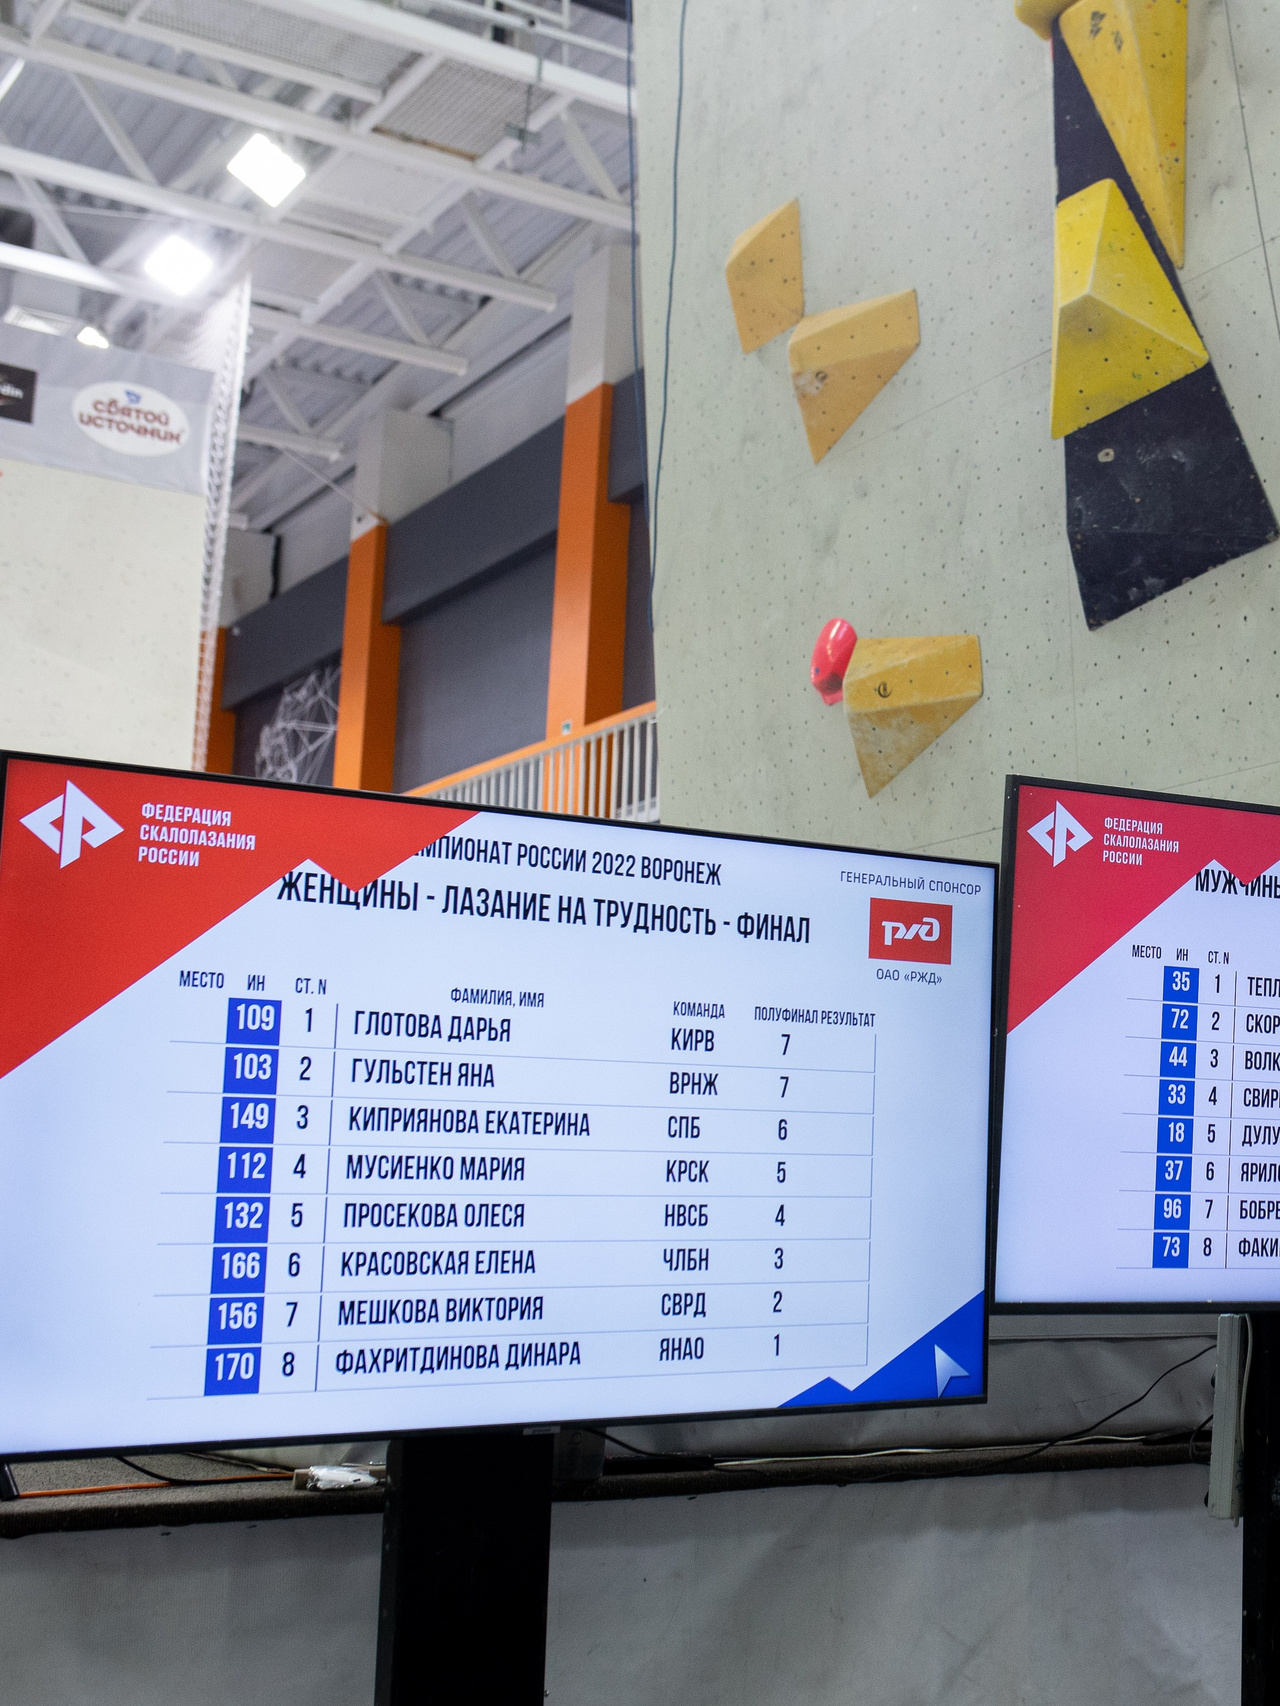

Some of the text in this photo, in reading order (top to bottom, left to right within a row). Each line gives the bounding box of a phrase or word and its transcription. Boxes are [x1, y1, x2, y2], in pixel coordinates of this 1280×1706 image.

[141, 802, 232, 827] ФЕДЕРАЦИЯ
[1104, 816, 1163, 835] ФЕДЕРАЦИЯ
[139, 824, 256, 851] СКАЛОЛАЗАНИЯ
[1103, 833, 1179, 853] СКАЛОЛАЗАНИЯ
[139, 846, 199, 866] РОССИИ
[517, 843, 586, 872] РОССИИ
[592, 852, 635, 877] 2022
[641, 856, 721, 885] ВОРОНЕЖ
[1103, 850, 1142, 865] РОССИИ
[841, 871, 981, 895] ГЕНЕРАЛЬНЫЙ СПОНСОР
[442, 885, 551, 922] ЛАЗАНИЕ
[558, 896, 586, 925] НА
[593, 899, 716, 935] ТРУДНОСТЬ
[737, 912, 809, 943] ФИНАЛ
[1132, 945, 1161, 959] МЕСТО
[1177, 948, 1188, 961] ИН
[1208, 951, 1221, 963] СТ.
[877, 969, 942, 985] ОАО «РЖД»
[1173, 971, 1190, 991] 35
[180, 970, 224, 988] МЕСТО
[247, 975, 265, 991] ИН
[296, 978, 313, 994] СТ.
[451, 988, 515, 1006] ФАМИЛИЯ,
[519, 992, 544, 1007] ИМЯ
[674, 1001, 725, 1019] КОМАНДА
[755, 1006, 818, 1023] ПОЛУФИНАЛ
[821, 1011, 875, 1027] РЕЗУЛЬТАТ
[237, 1004, 714, 1051] 109 ГЛОТОВА ДАРЬЯ КИРВ
[1172, 1008, 1189, 1029] 72
[1169, 1046, 1187, 1066] 44
[234, 1053, 718, 1095] 103 ГУЛЬСТЕН ЯНА ВРНЖ
[1168, 1084, 1185, 1104] 33
[231, 1102, 700, 1138] 149 КИПРИЯНОВА ЕКАТЕРИНА СПБ
[1169, 1122, 1184, 1142] 18
[228, 1152, 709, 1182] 112 МУСИЕНКО МАРИЯ КРСК
[1165, 1160, 1183, 1180] 37
[225, 1202, 708, 1228] 132 ПРОСЕКОВА ОЛЕСЯ НВСБ
[1164, 1198, 1181, 1218] 96
[1163, 1237, 1180, 1257] 73
[222, 1248, 708, 1279] 166 КРАСОВСКАЯ ЕЛЕНА ЧЛБН
[219, 1293, 706, 1329] 156 МЕШКОВА ВИКТОРИЯ СВРД
[215, 1337, 704, 1380] 170 ФАХРИТДИНОВА ДИНАРА ЯНАО
